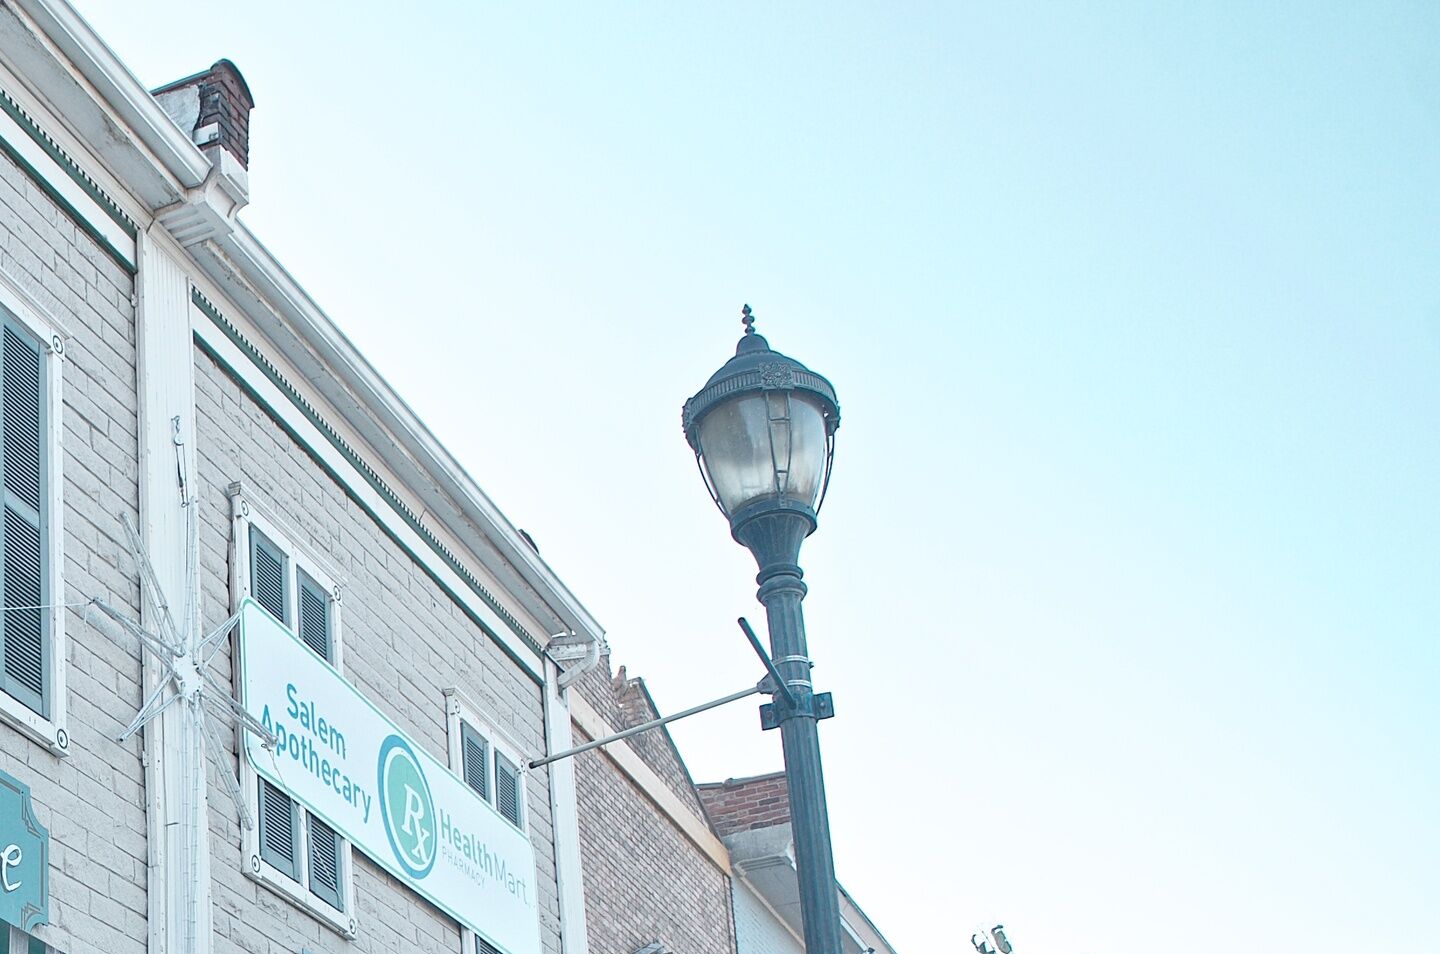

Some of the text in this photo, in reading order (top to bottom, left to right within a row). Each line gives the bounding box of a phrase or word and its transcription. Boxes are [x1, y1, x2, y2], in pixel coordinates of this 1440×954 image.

[286, 683, 346, 760] Salem
[261, 704, 372, 824] Apothecary
[442, 846, 485, 889] PHARMACY
